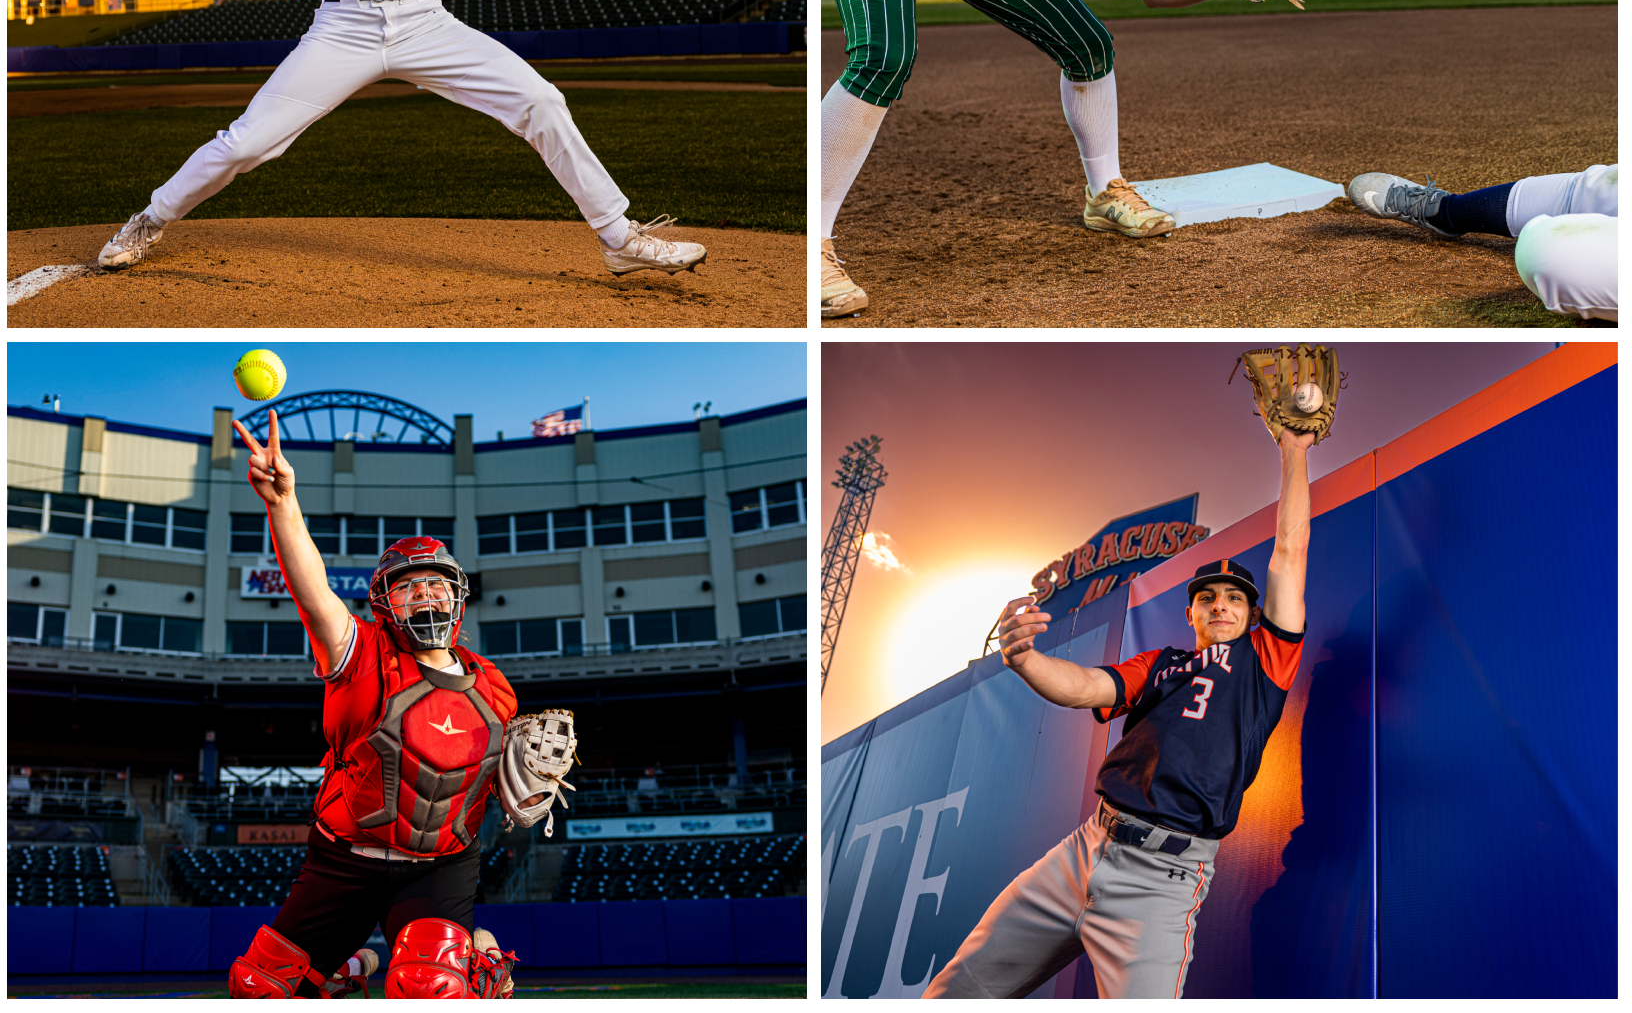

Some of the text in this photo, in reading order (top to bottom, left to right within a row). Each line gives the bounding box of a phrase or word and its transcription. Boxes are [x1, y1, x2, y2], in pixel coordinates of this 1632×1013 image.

[1030, 521, 1211, 606] SYRACUSE
[1220, 558, 1234, 576] L
[1181, 676, 1215, 721] 3
[504, 719, 533, 736] EASTON
[249, 829, 296, 842] KASAI
